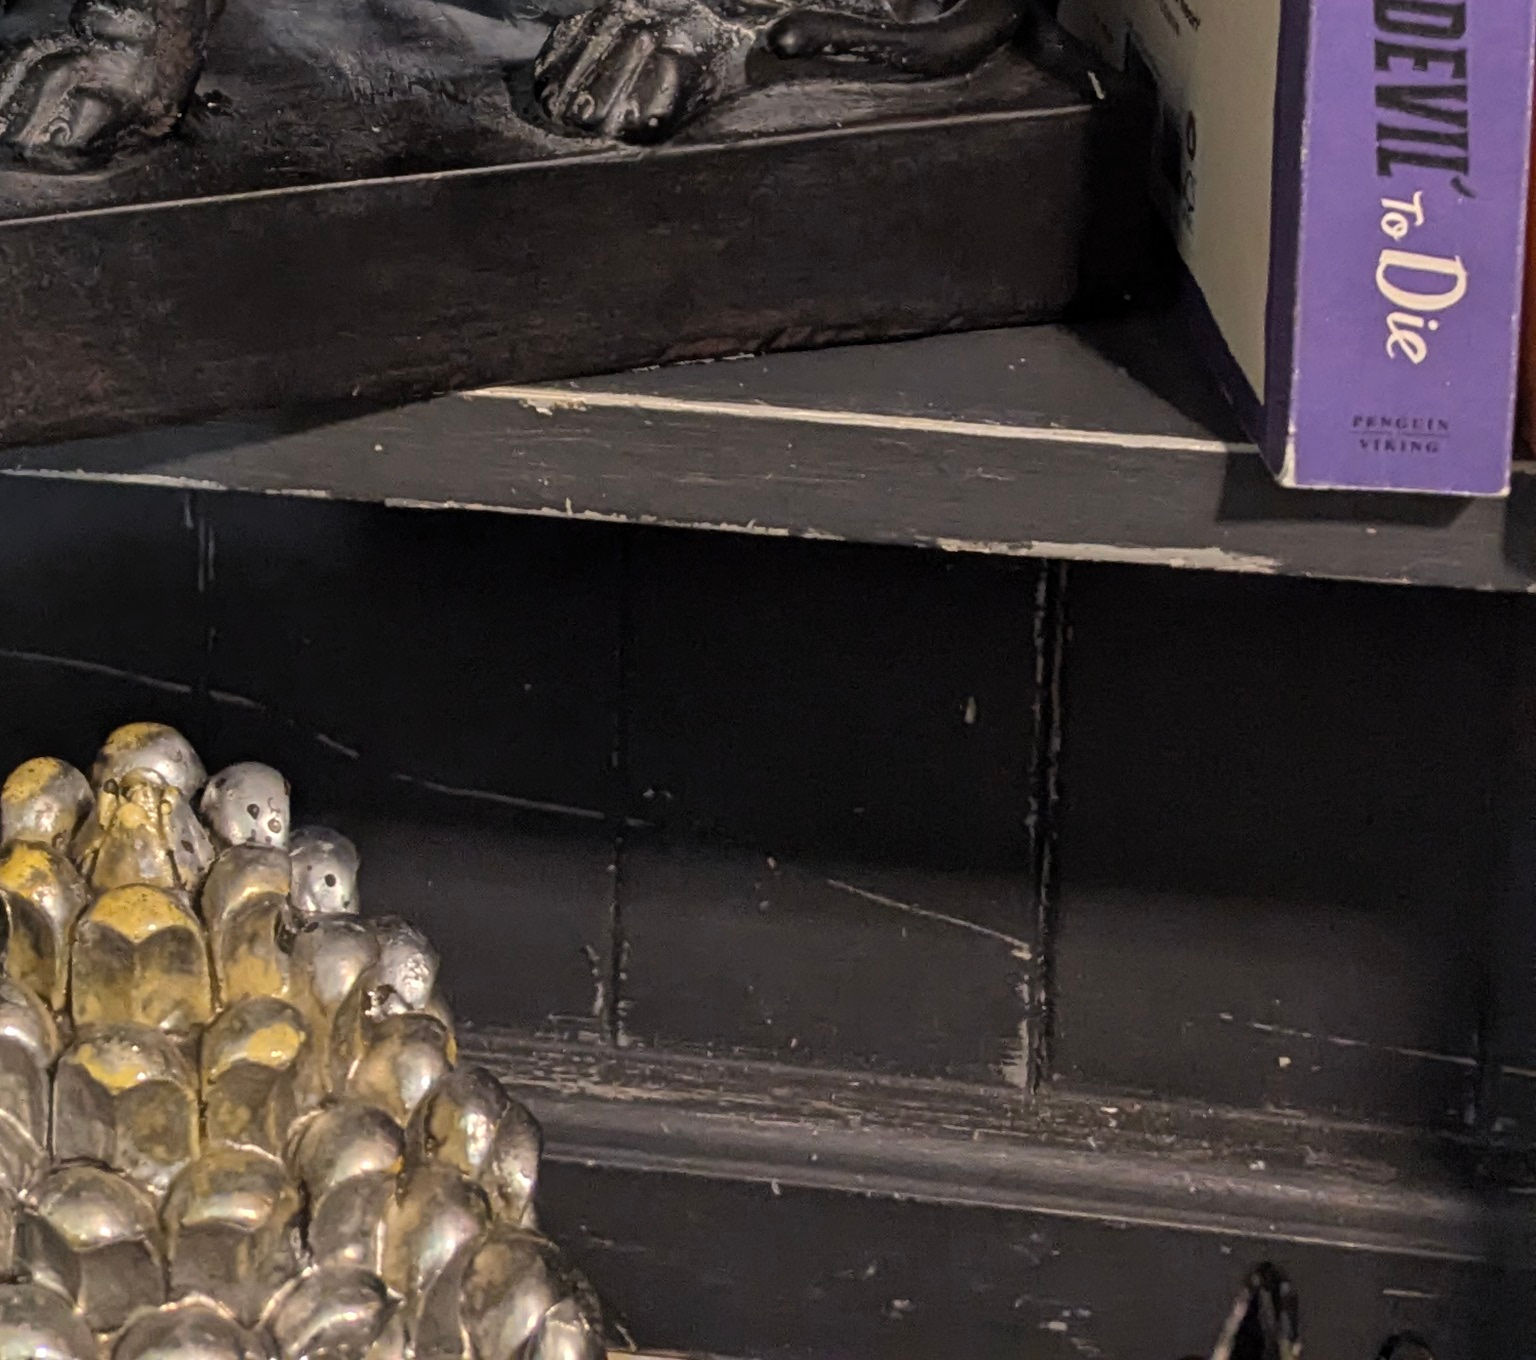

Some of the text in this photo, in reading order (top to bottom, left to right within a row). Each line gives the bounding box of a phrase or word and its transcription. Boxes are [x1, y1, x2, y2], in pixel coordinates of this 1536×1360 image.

[1376, 191, 1468, 364] To Die
[1352, 415, 1449, 431] PENGUIN
[1360, 438, 1439, 453] VIKING
